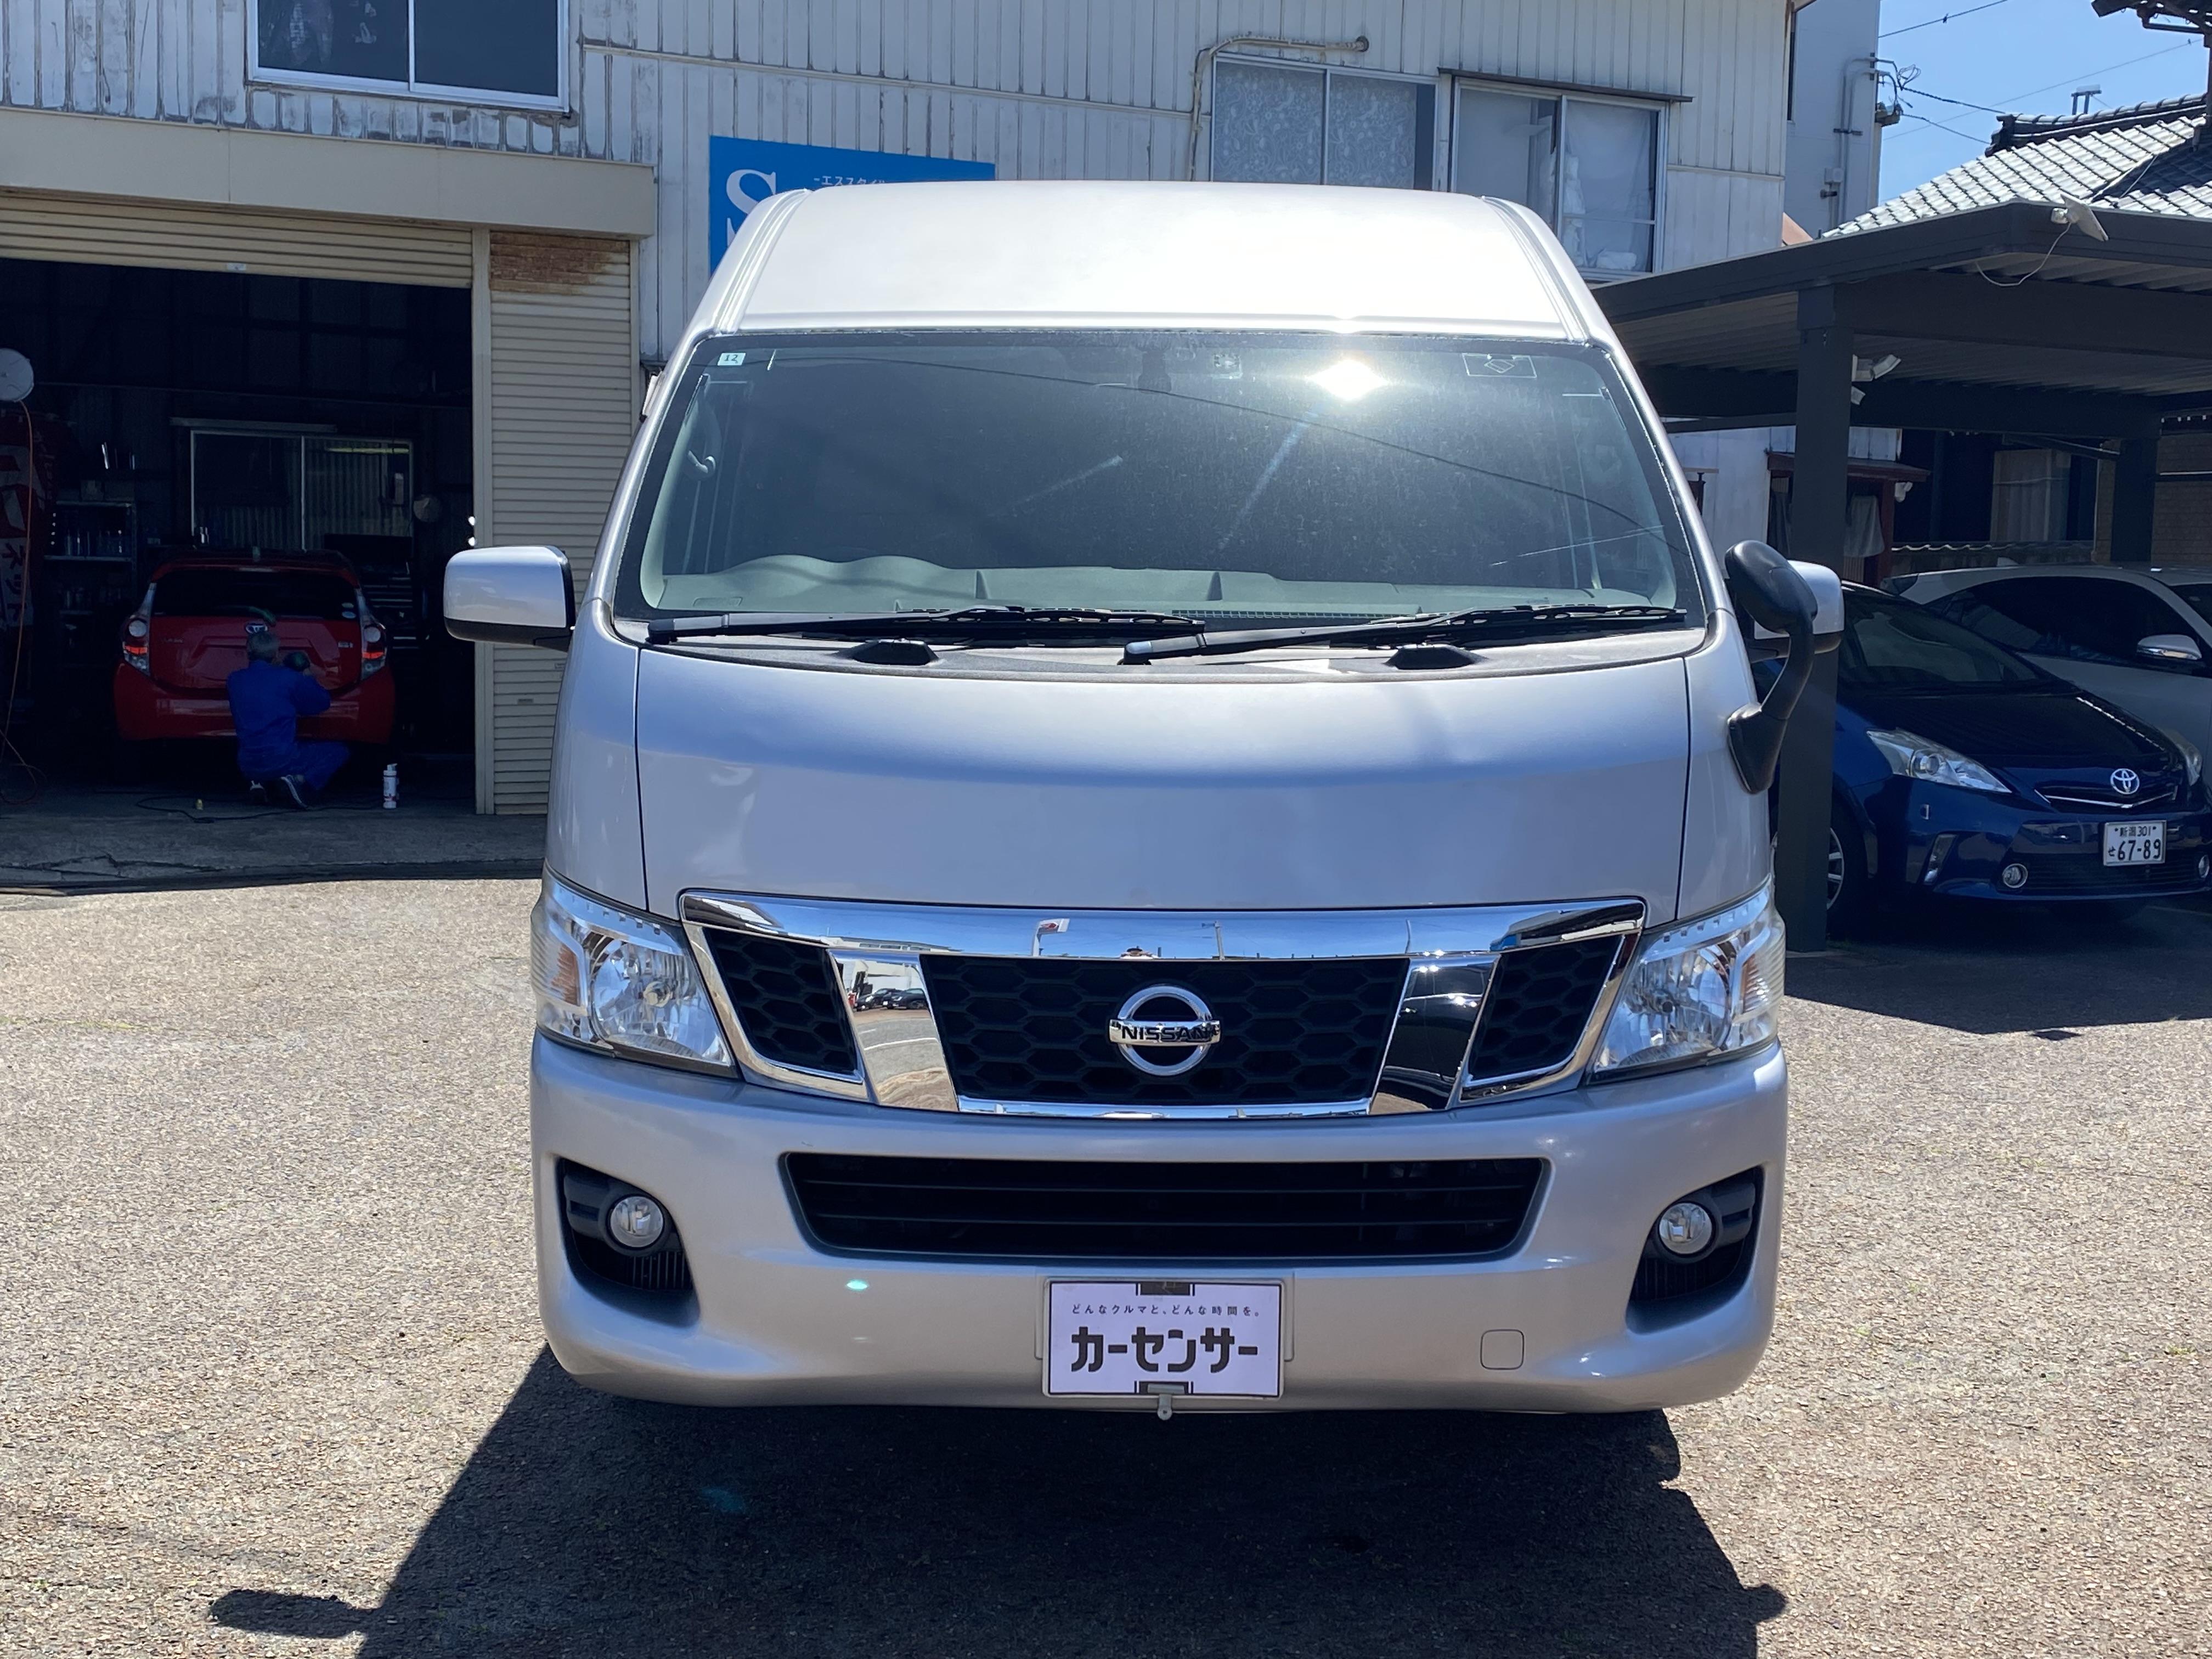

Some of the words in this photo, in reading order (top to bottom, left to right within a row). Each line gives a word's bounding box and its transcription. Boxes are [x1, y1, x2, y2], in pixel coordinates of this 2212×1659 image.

[2118, 839, 2161, 861] 67-89
[1122, 1026, 1212, 1041] NISSAN
[1072, 1304, 1260, 1317] どんなクルマと、どんな時間を。
[1071, 1327, 1259, 1373] カーセンサー
